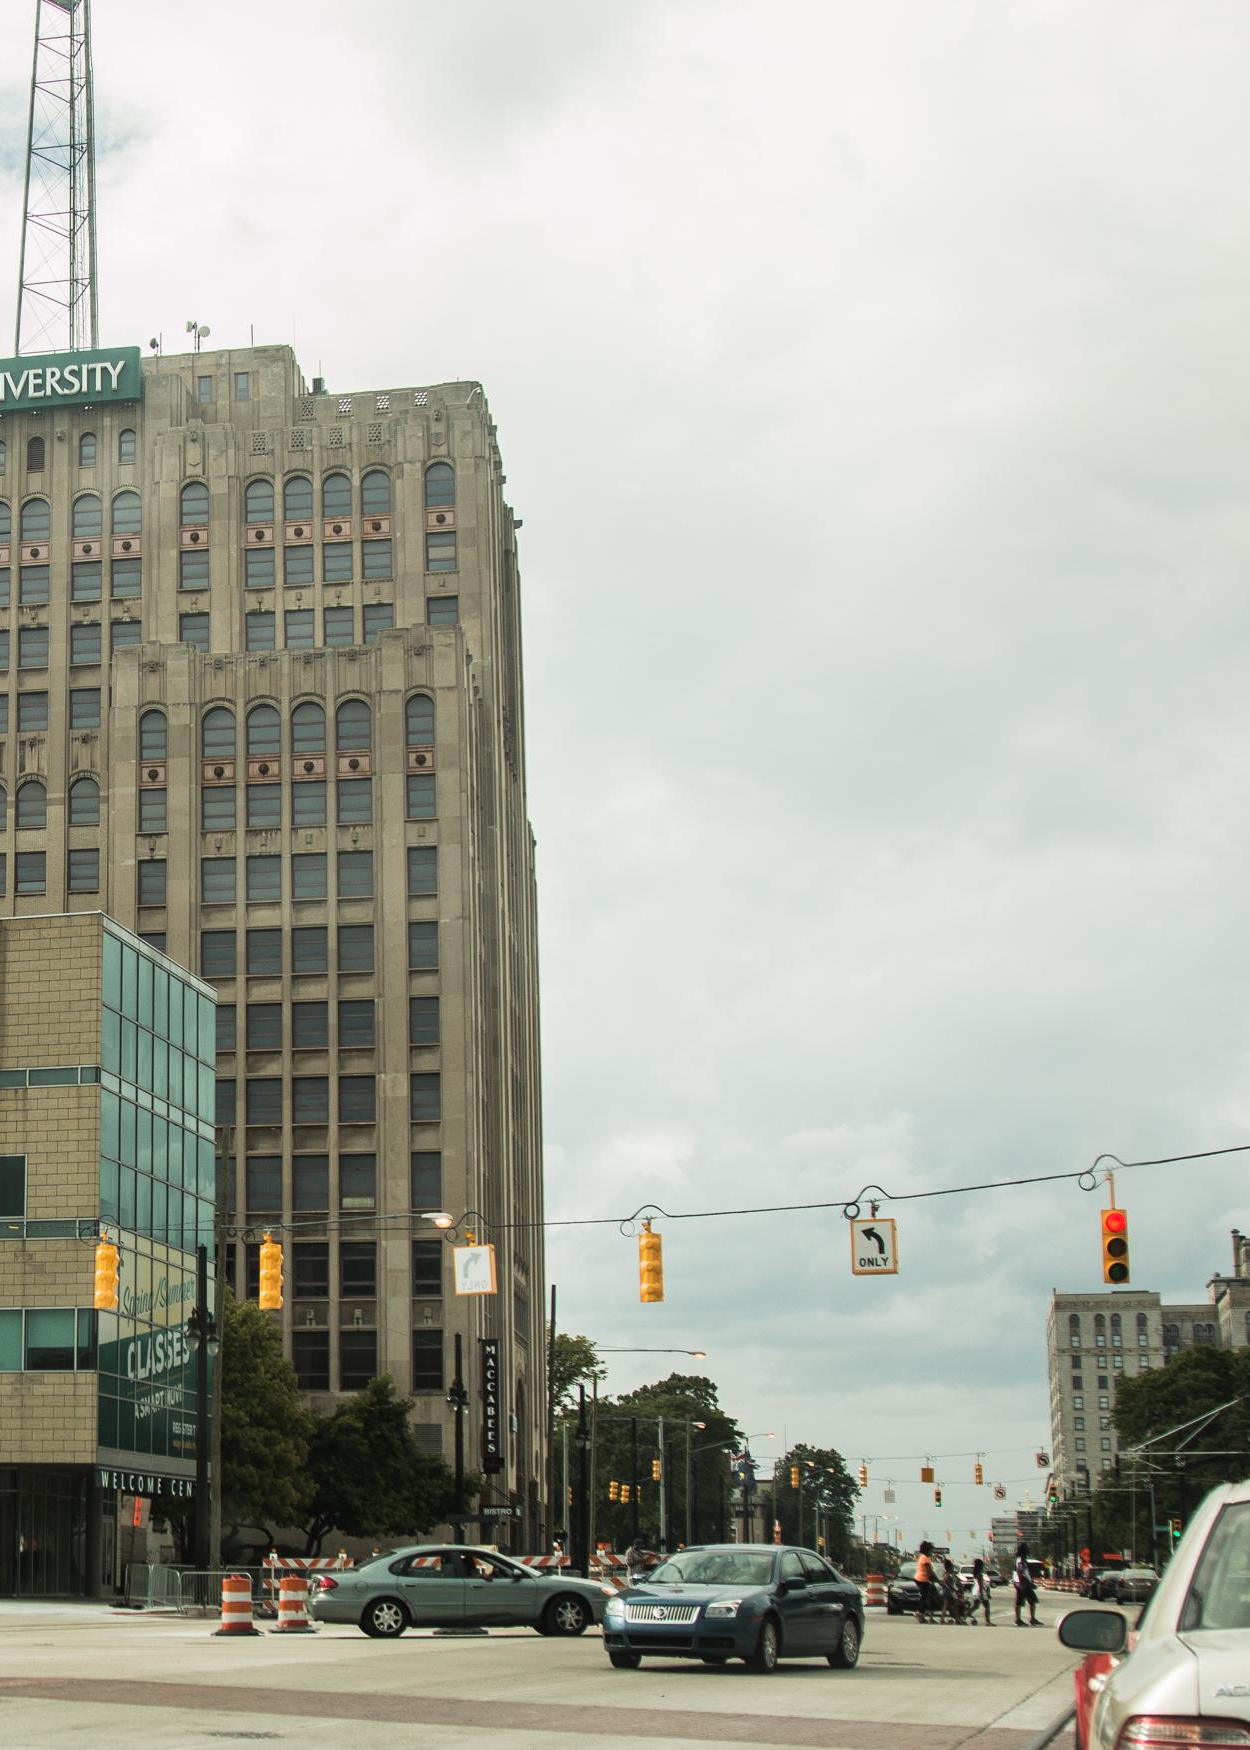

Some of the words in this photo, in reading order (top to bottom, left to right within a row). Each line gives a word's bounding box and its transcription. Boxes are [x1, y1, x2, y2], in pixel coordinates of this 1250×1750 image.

[859, 1256, 889, 1267] ONLY
[485, 1345, 496, 1453] MACCABEES
[101, 1471, 162, 1495] WELCOME
